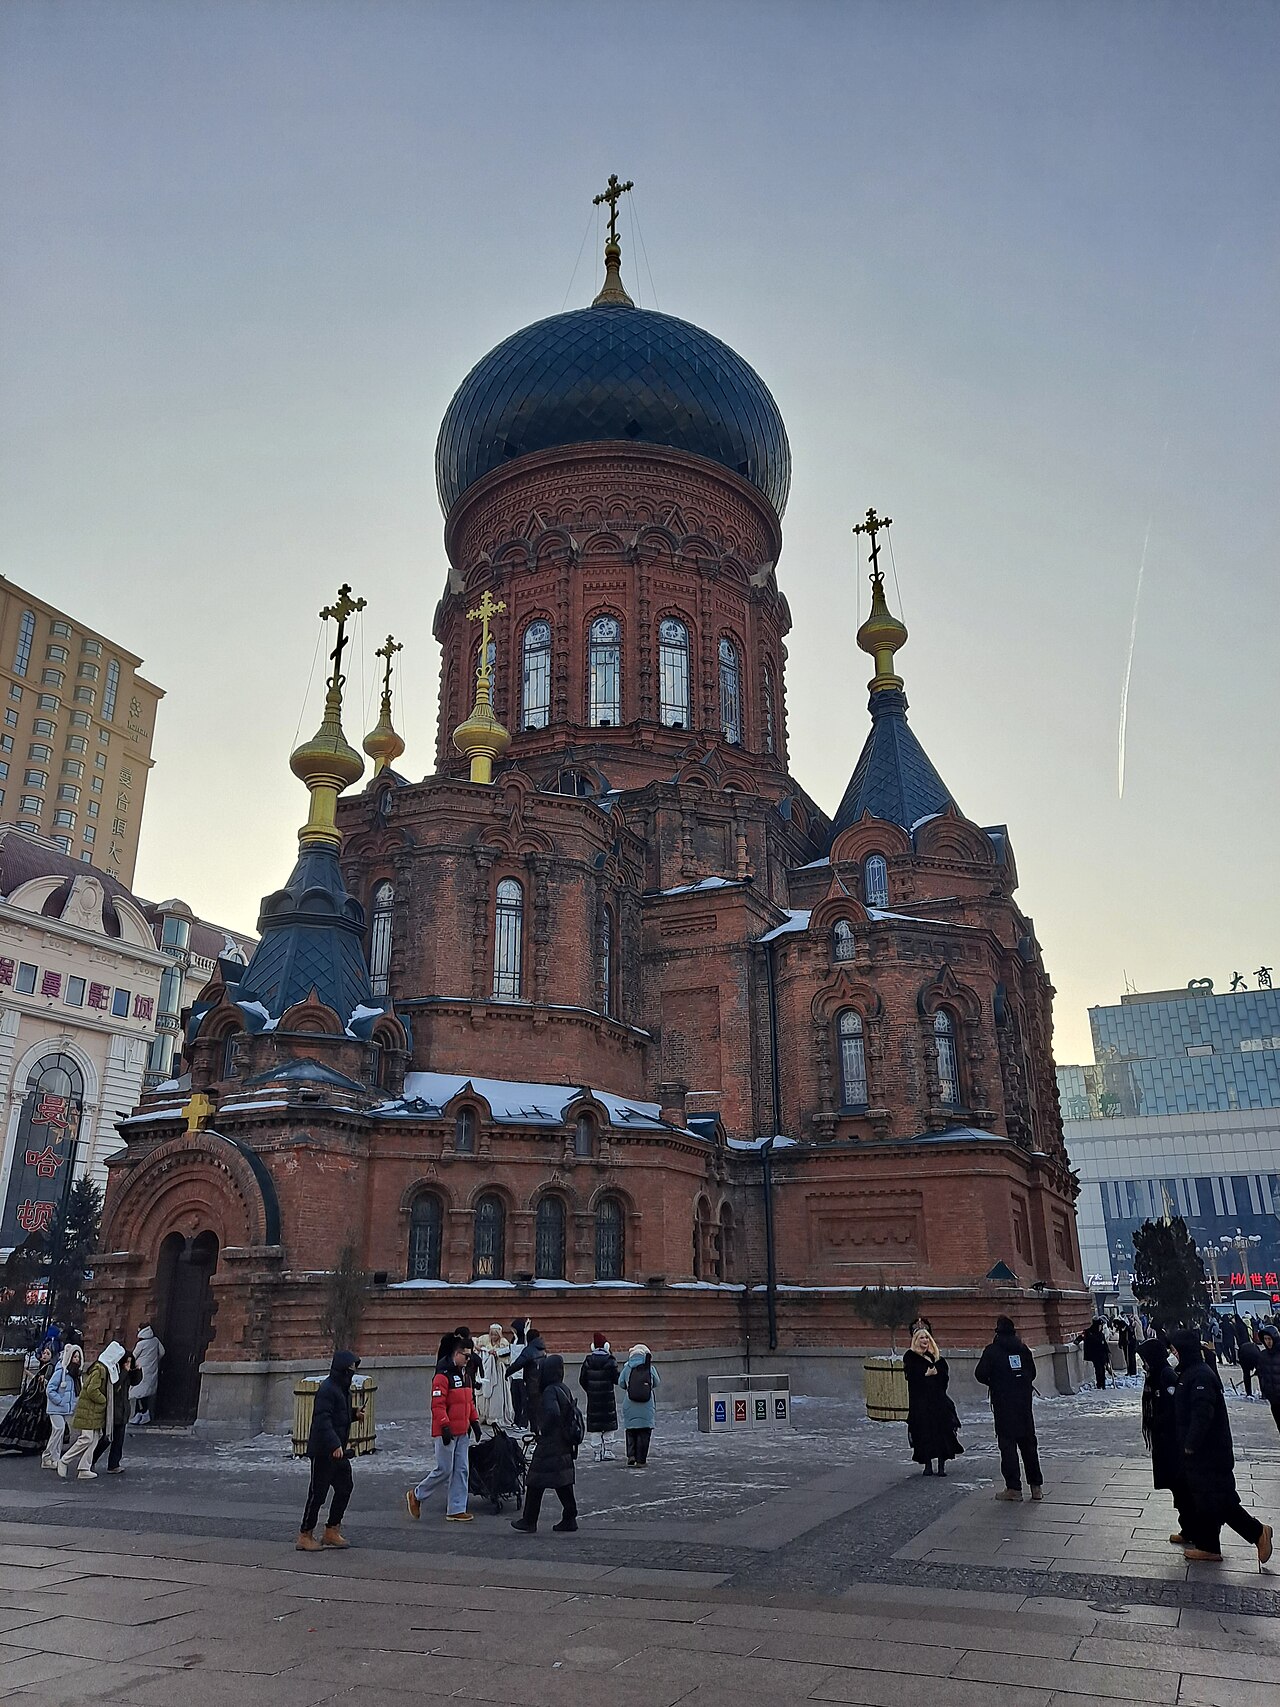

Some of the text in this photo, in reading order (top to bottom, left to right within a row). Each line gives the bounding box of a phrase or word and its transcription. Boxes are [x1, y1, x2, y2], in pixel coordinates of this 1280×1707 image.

[1229, 966, 1274, 992] 大商
[17, 1094, 70, 1232] 曼哈顿
